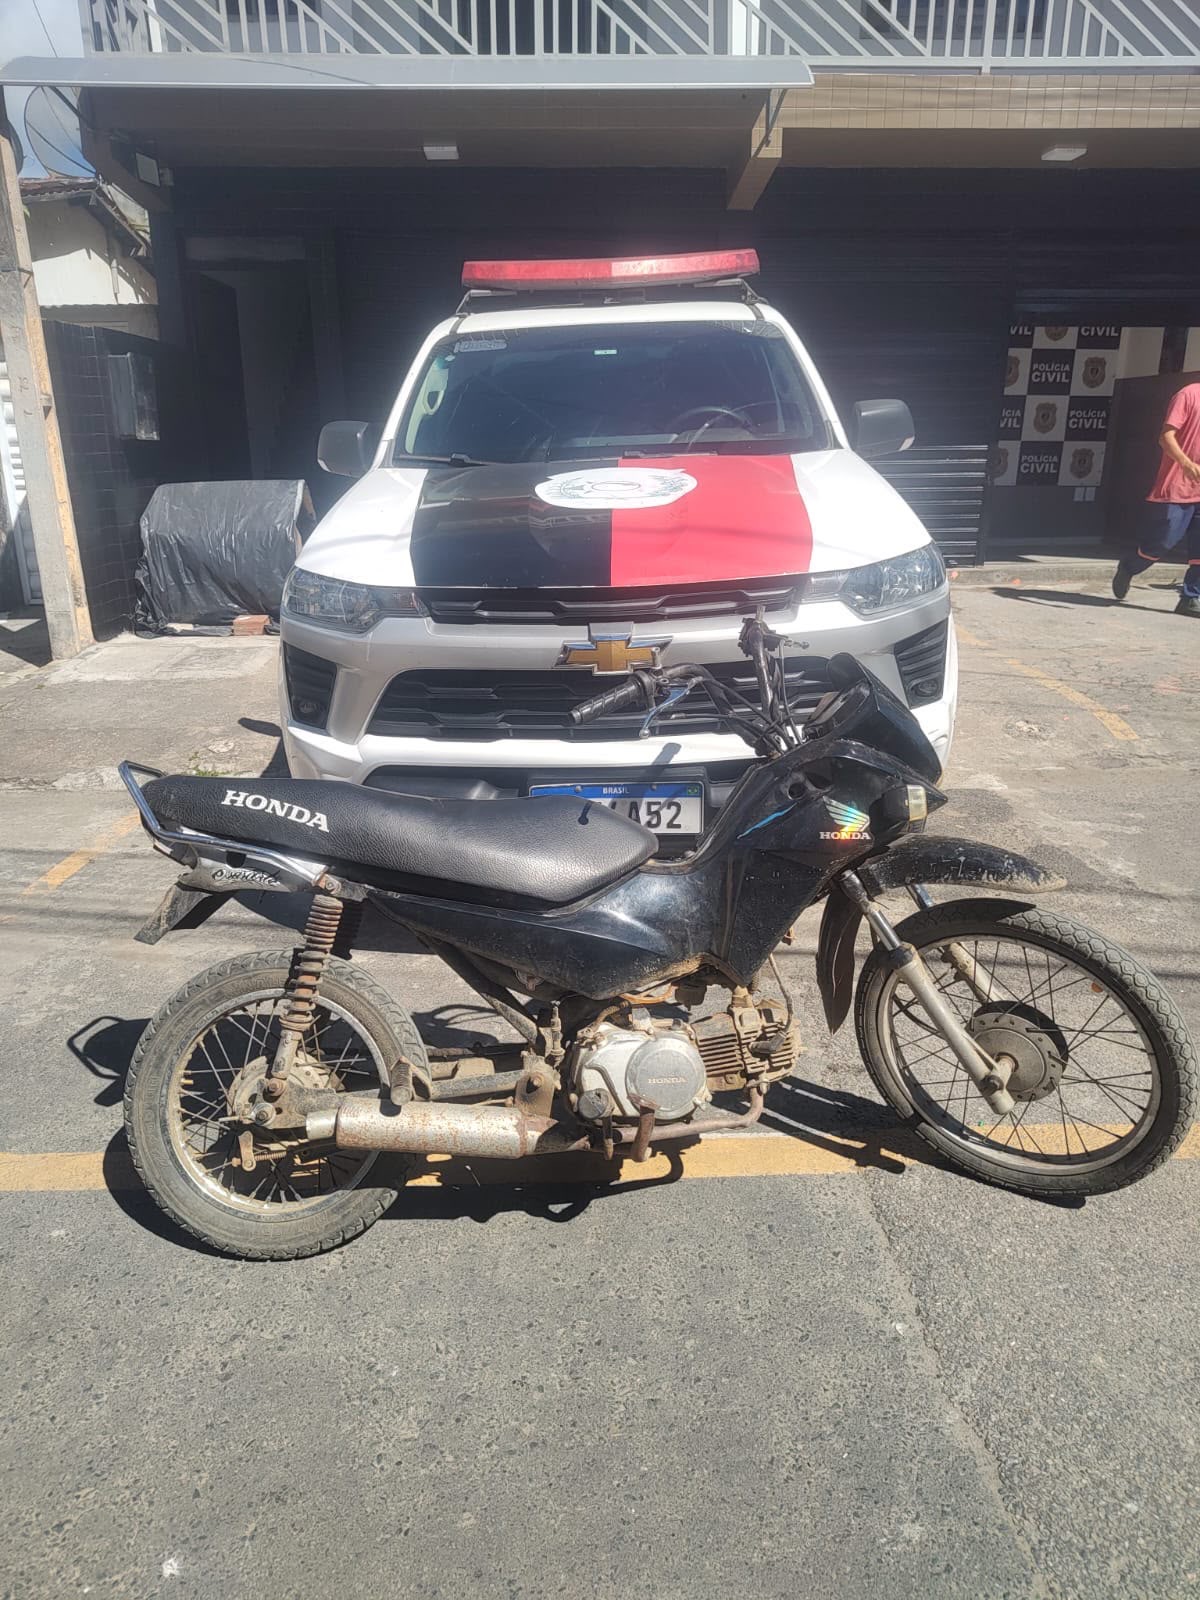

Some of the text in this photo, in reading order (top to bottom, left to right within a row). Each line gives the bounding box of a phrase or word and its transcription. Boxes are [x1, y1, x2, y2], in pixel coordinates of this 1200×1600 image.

[1081, 326, 1118, 336] CIVIL
[1032, 363, 1070, 371] POLÍCIA
[1031, 372, 1069, 382] CIVIL
[1069, 410, 1106, 418] POLÍCIA
[1068, 419, 1106, 428] CIVIL
[1021, 455, 1058, 463] POLÍCIA
[1020, 463, 1057, 473] CIVIL
[602, 787, 630, 795] BRASIL
[221, 789, 330, 833] HONDA
[819, 831, 871, 840] HONDA
